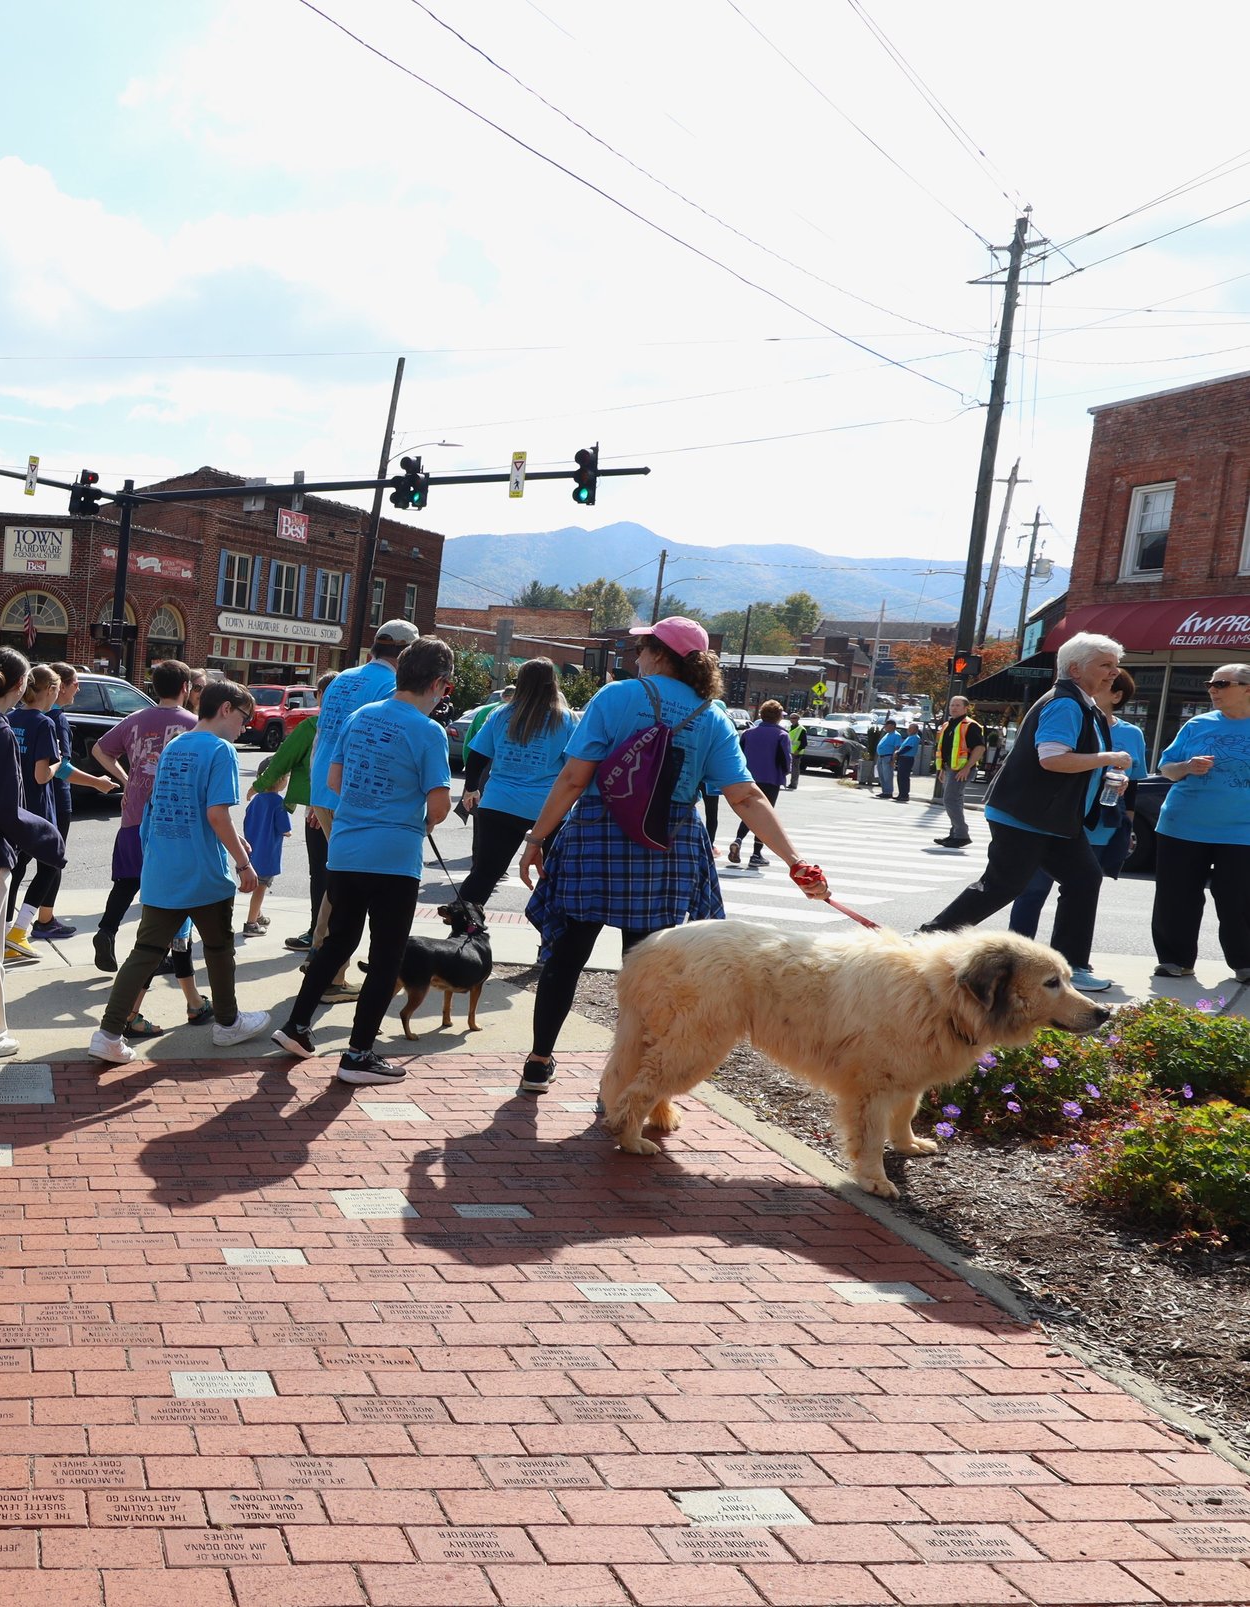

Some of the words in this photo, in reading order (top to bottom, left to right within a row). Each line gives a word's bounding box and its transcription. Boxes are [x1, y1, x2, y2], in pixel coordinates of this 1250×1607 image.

[281, 515, 307, 540] Best
[14, 530, 64, 545] TOWN
[14, 543, 62, 554] HARDWARE
[28, 562, 45, 571] Best
[224, 616, 244, 628] TOWN
[248, 618, 280, 632] HARDWARE
[284, 625, 288, 633] &
[292, 625, 317, 637] GENERAL
[320, 628, 338, 640] STORE
[622, 726, 659, 764] EDDIE
